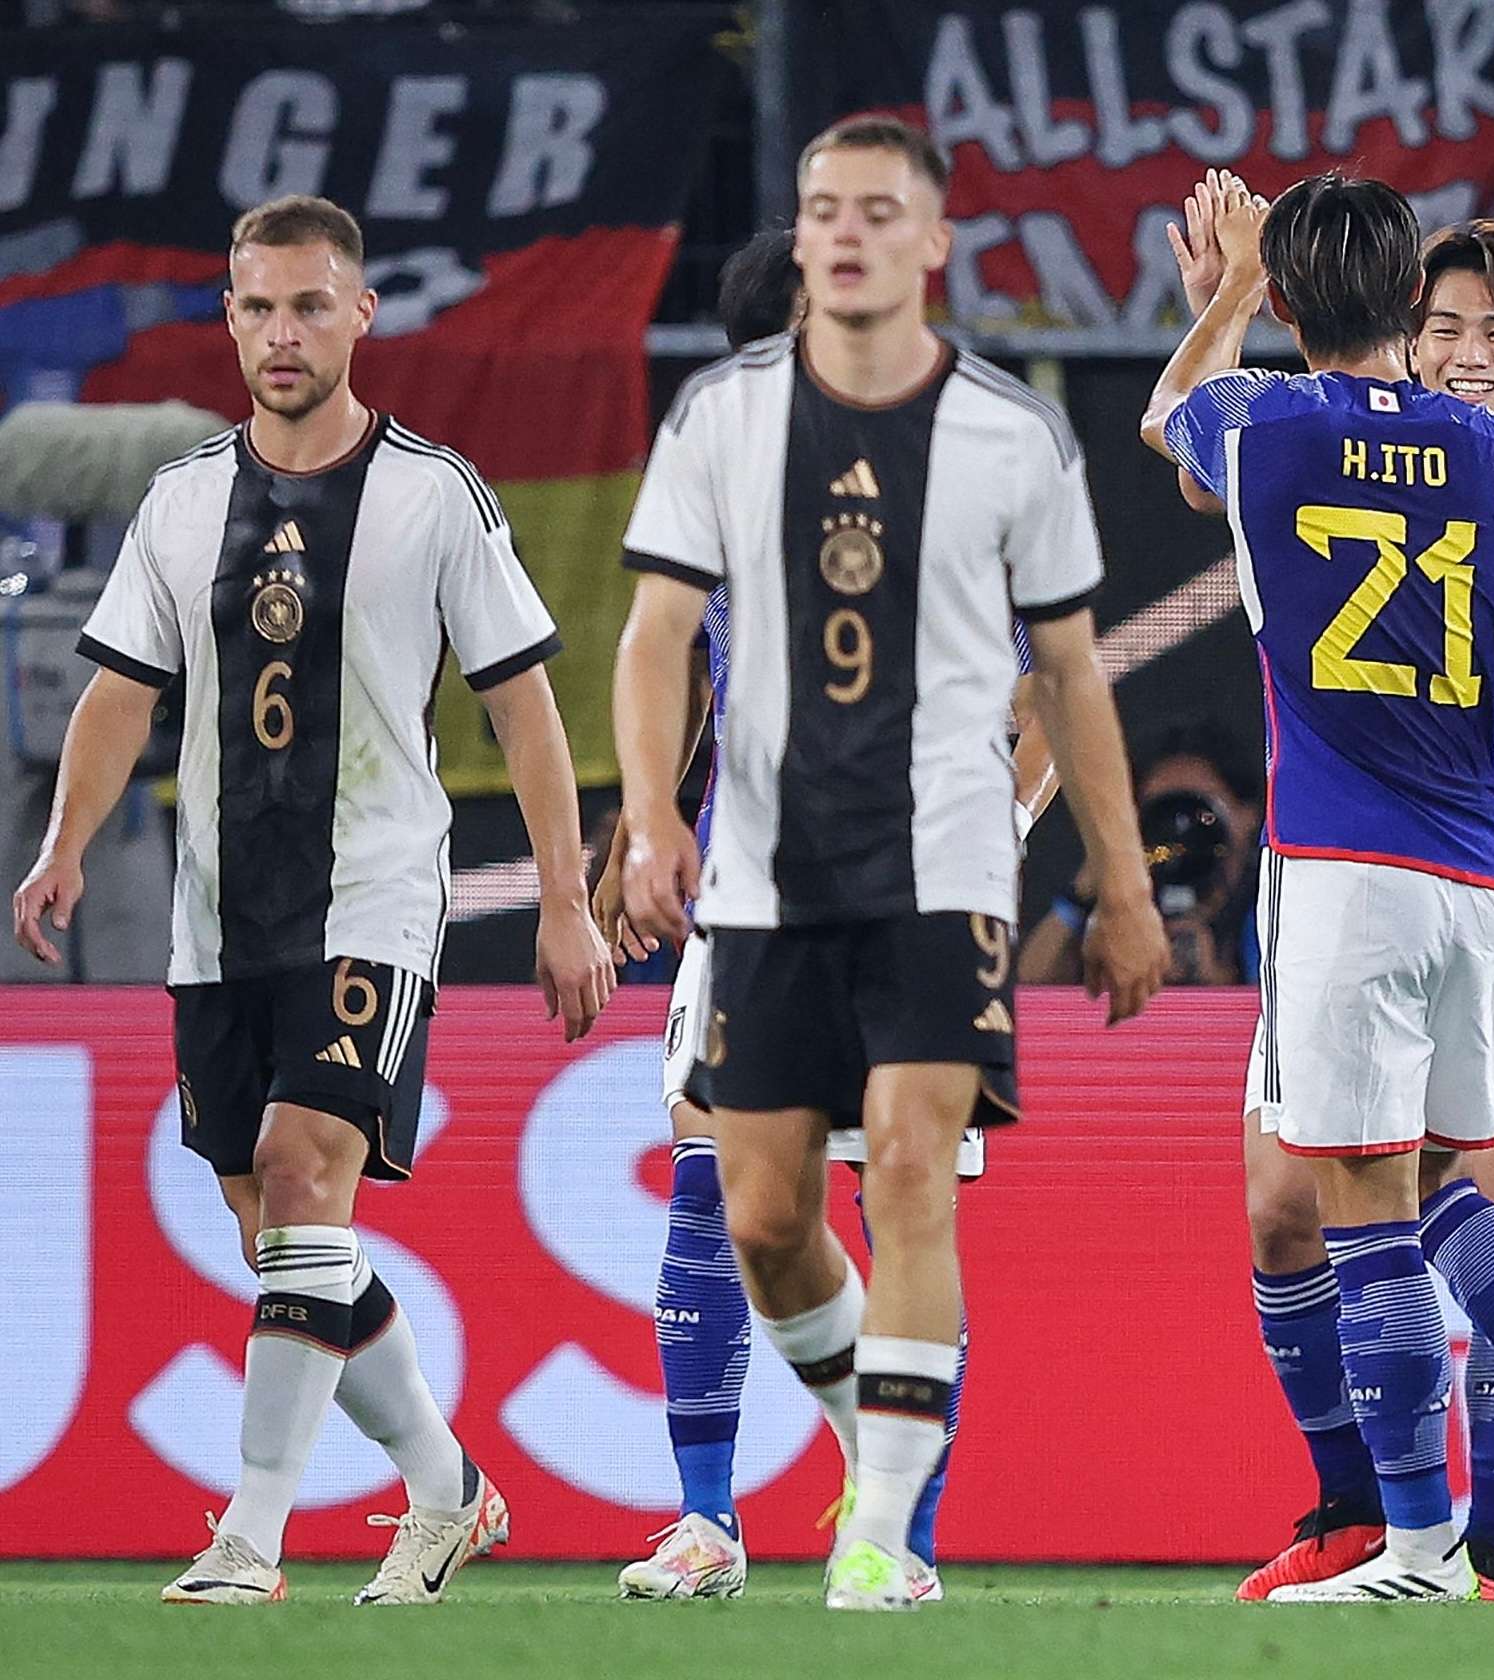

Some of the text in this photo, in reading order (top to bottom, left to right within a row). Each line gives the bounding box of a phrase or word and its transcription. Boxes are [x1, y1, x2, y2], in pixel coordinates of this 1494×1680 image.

[1342, 437, 1447, 487] H.ITO
[1296, 504, 1482, 709] 21
[823, 608, 873, 704] 9
[253, 660, 294, 750] 6
[969, 910, 1010, 990] 9
[332, 957, 377, 1026] 6
[260, 1303, 308, 1321] DFB
